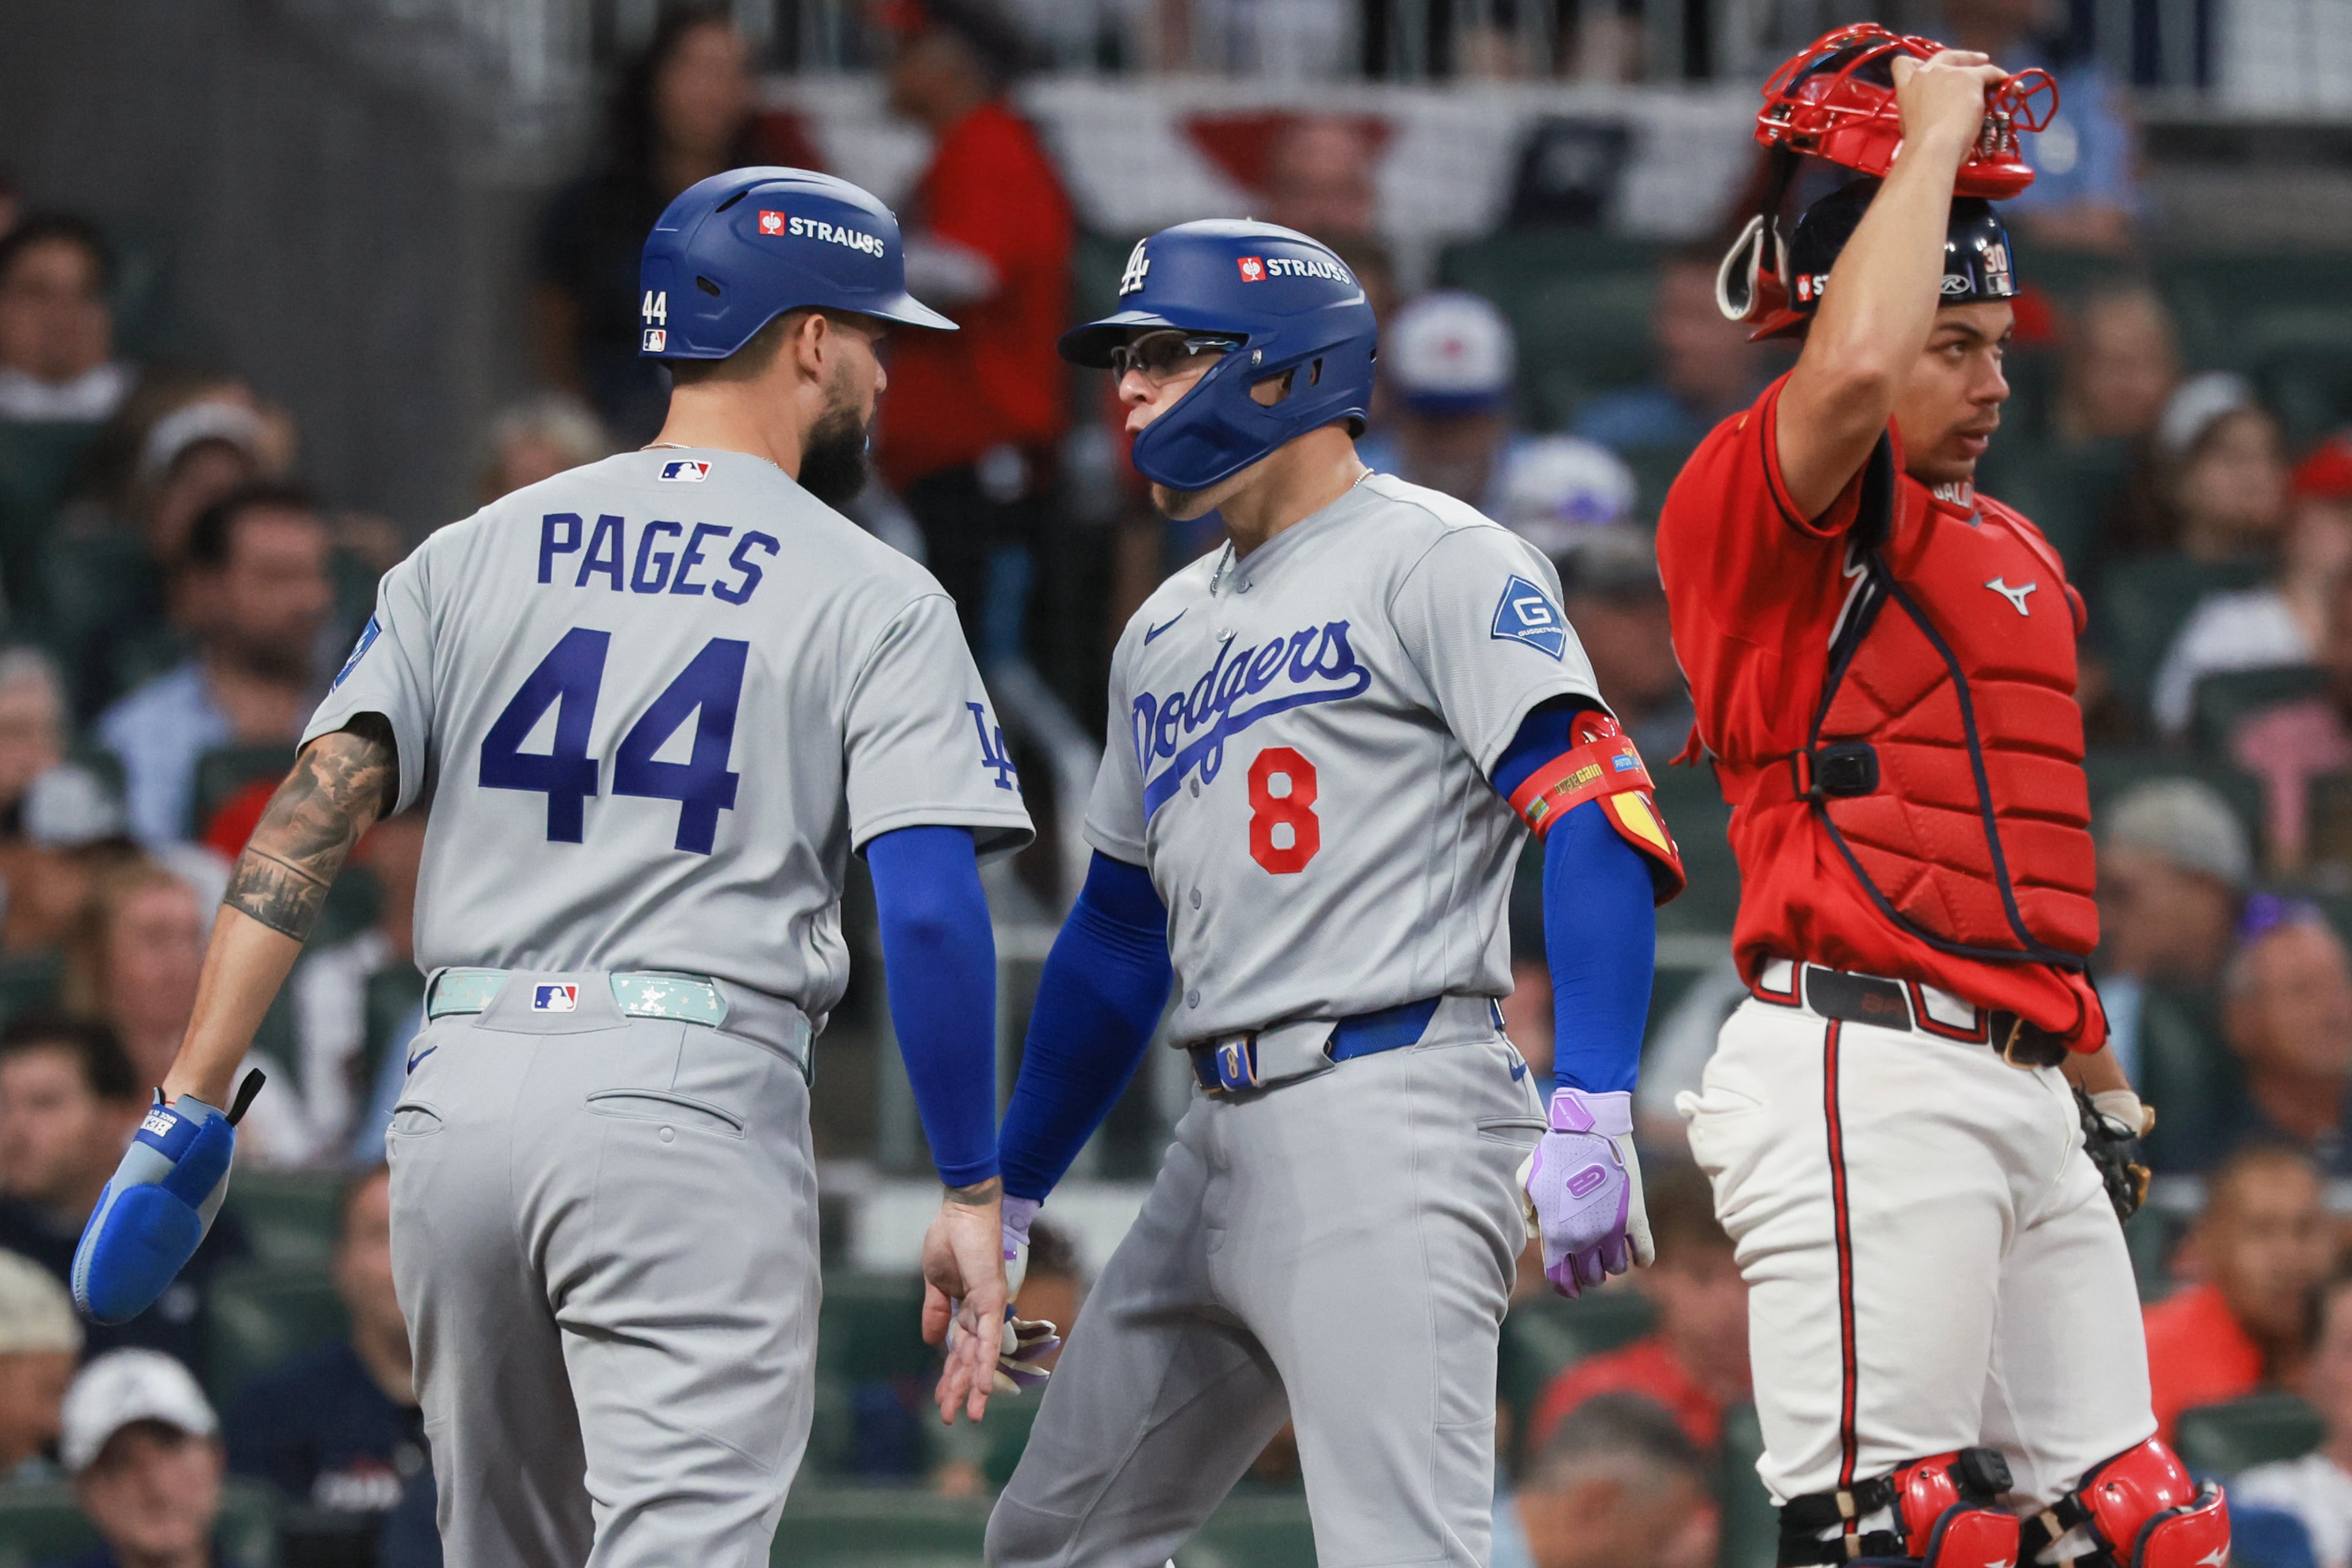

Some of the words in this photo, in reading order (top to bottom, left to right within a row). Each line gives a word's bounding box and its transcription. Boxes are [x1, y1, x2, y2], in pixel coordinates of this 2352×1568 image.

[789, 217, 884, 258] STRAUSS
[1119, 238, 1150, 296] LA
[1267, 258, 1351, 285] STRAUSS
[1983, 244, 2008, 273] 30
[642, 290, 667, 325] 44
[537, 513, 780, 606] PAGES
[1512, 597, 1552, 627] G
[1133, 620, 1371, 785] Dodgers
[478, 627, 749, 855] 44
[1248, 747, 1320, 875] 8
[1227, 1050, 1238, 1079] 8
